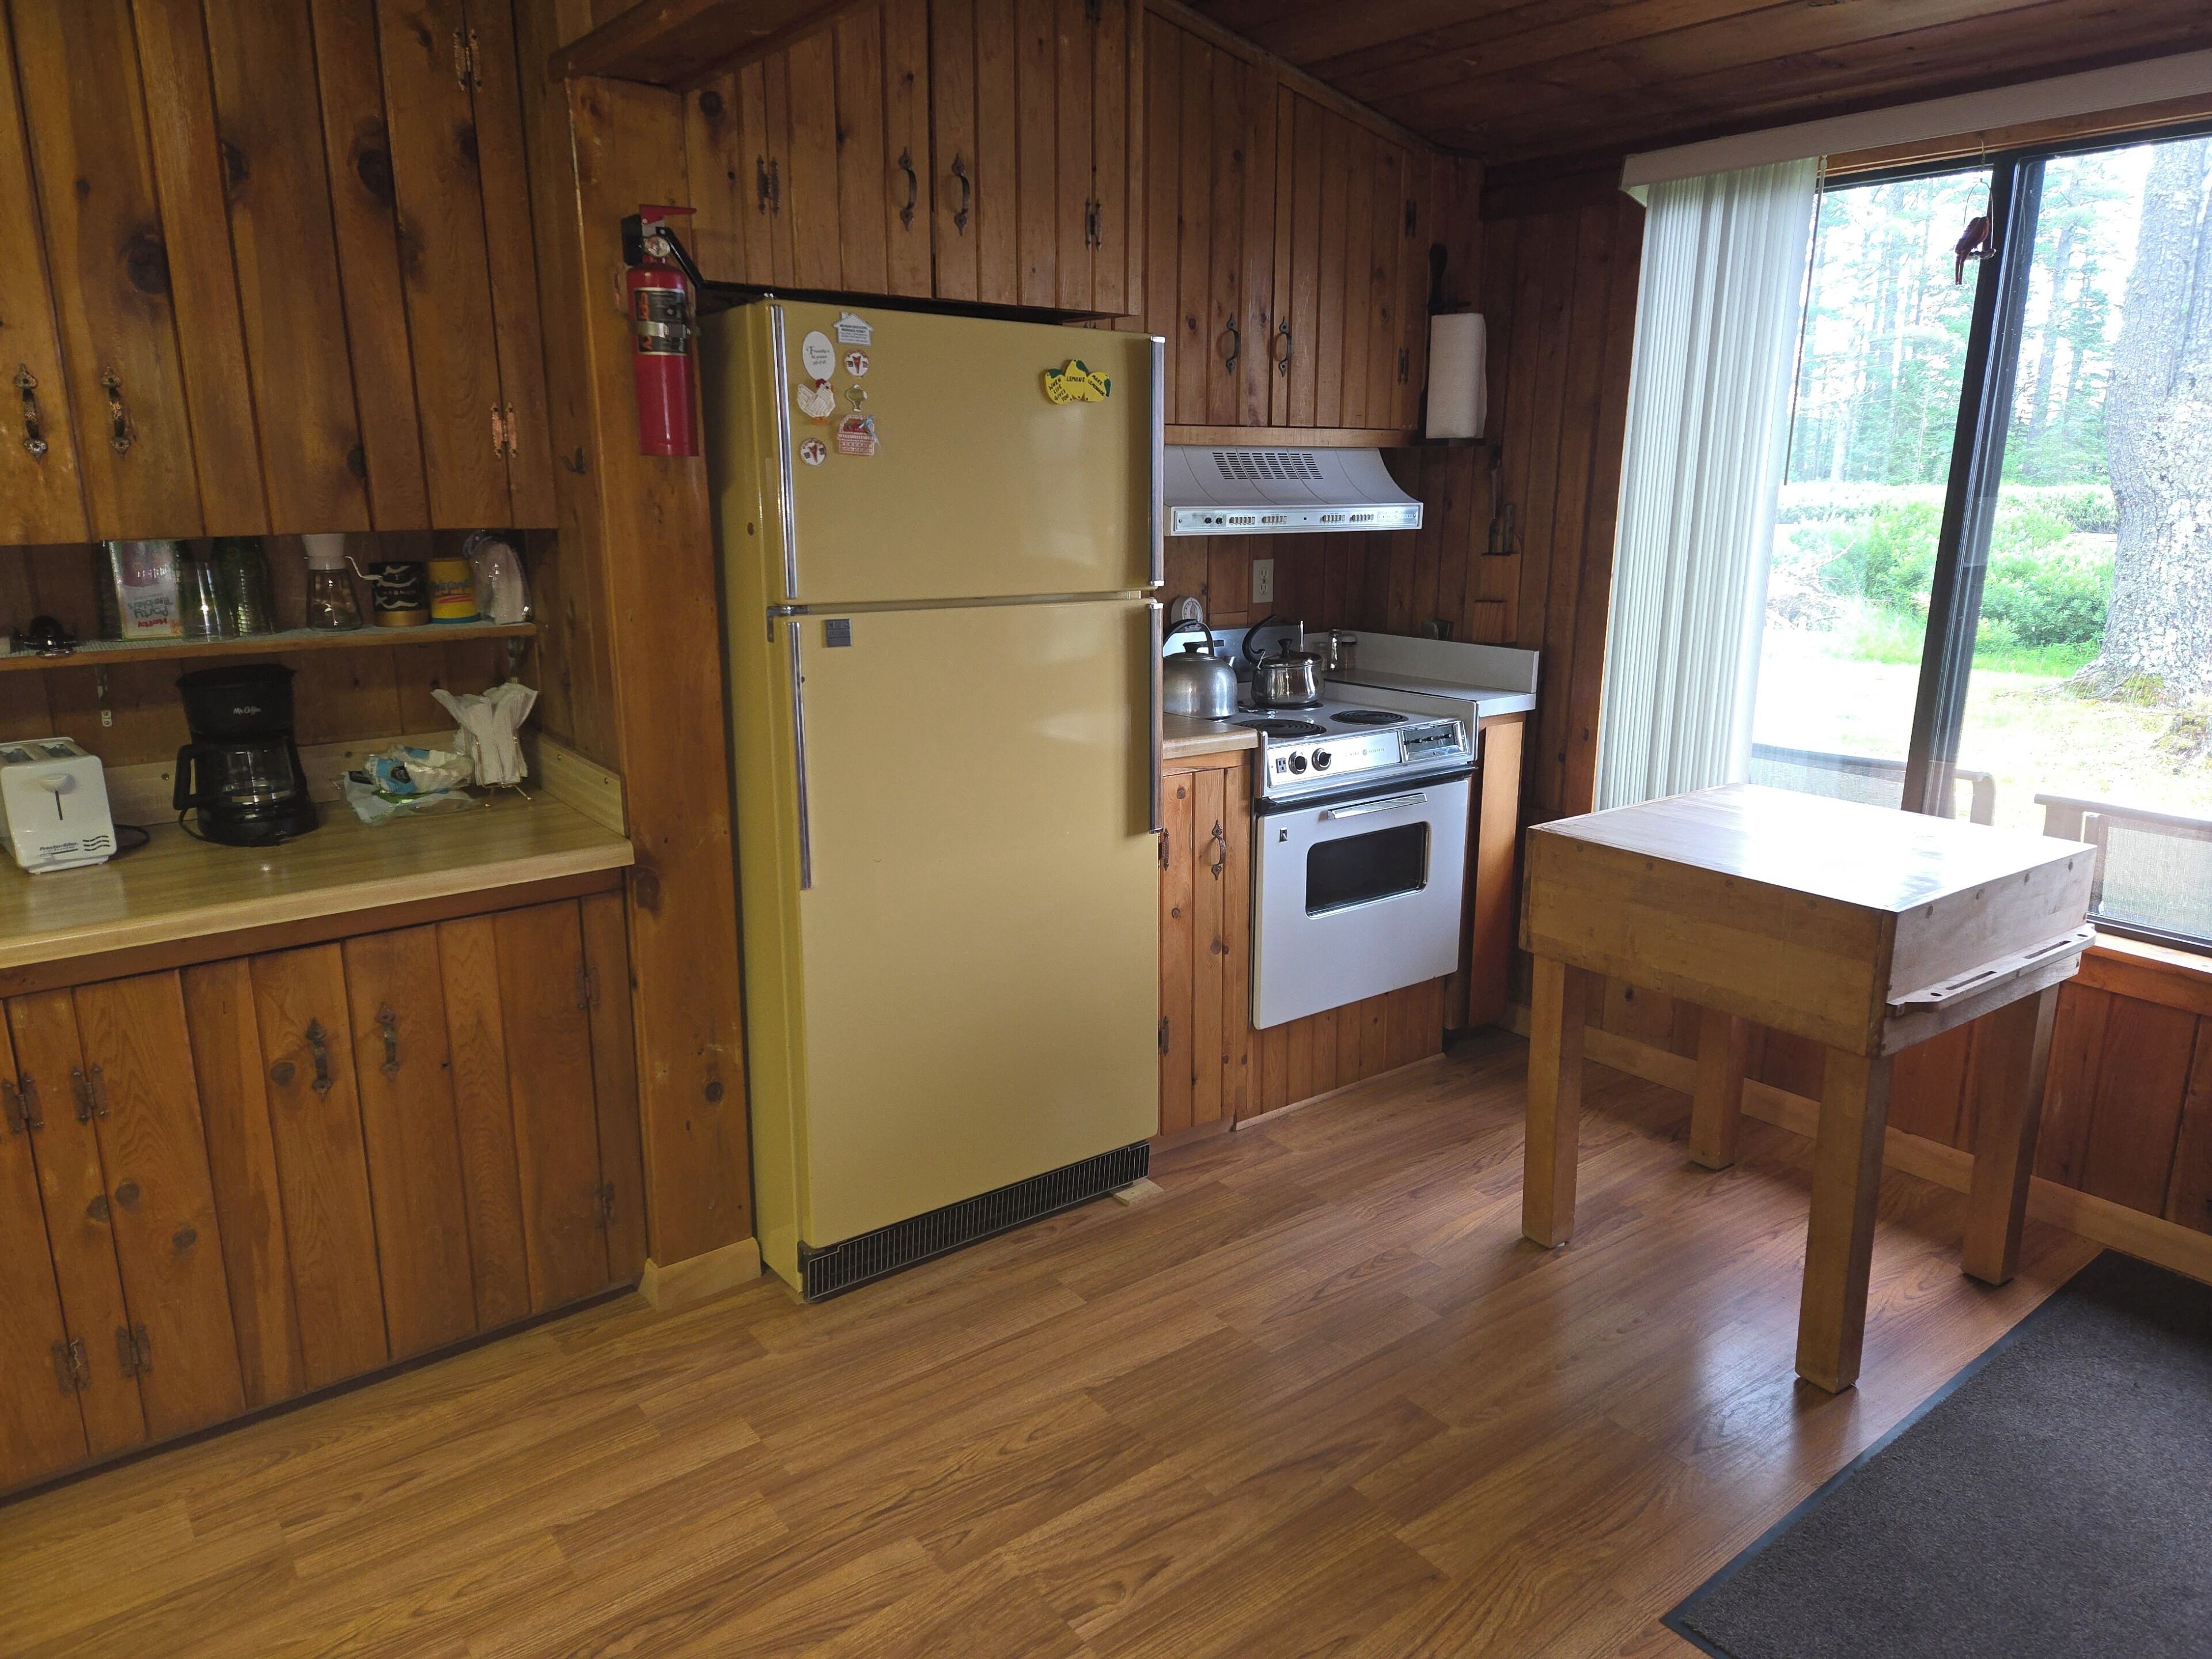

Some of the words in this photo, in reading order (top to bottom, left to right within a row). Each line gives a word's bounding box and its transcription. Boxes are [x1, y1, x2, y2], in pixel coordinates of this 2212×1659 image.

[1048, 377, 1062, 391] WHEN
[1092, 374, 1103, 386] MAKE
[1053, 385, 1063, 394] LIFE
[1088, 380, 1105, 397] LEMONADE
[1054, 390, 1066, 400] GIVES
[1062, 394, 1070, 402] YOU
[128, 597, 173, 609] Tumblers
[134, 606, 169, 619] Party
[138, 618, 168, 628] Hefty
